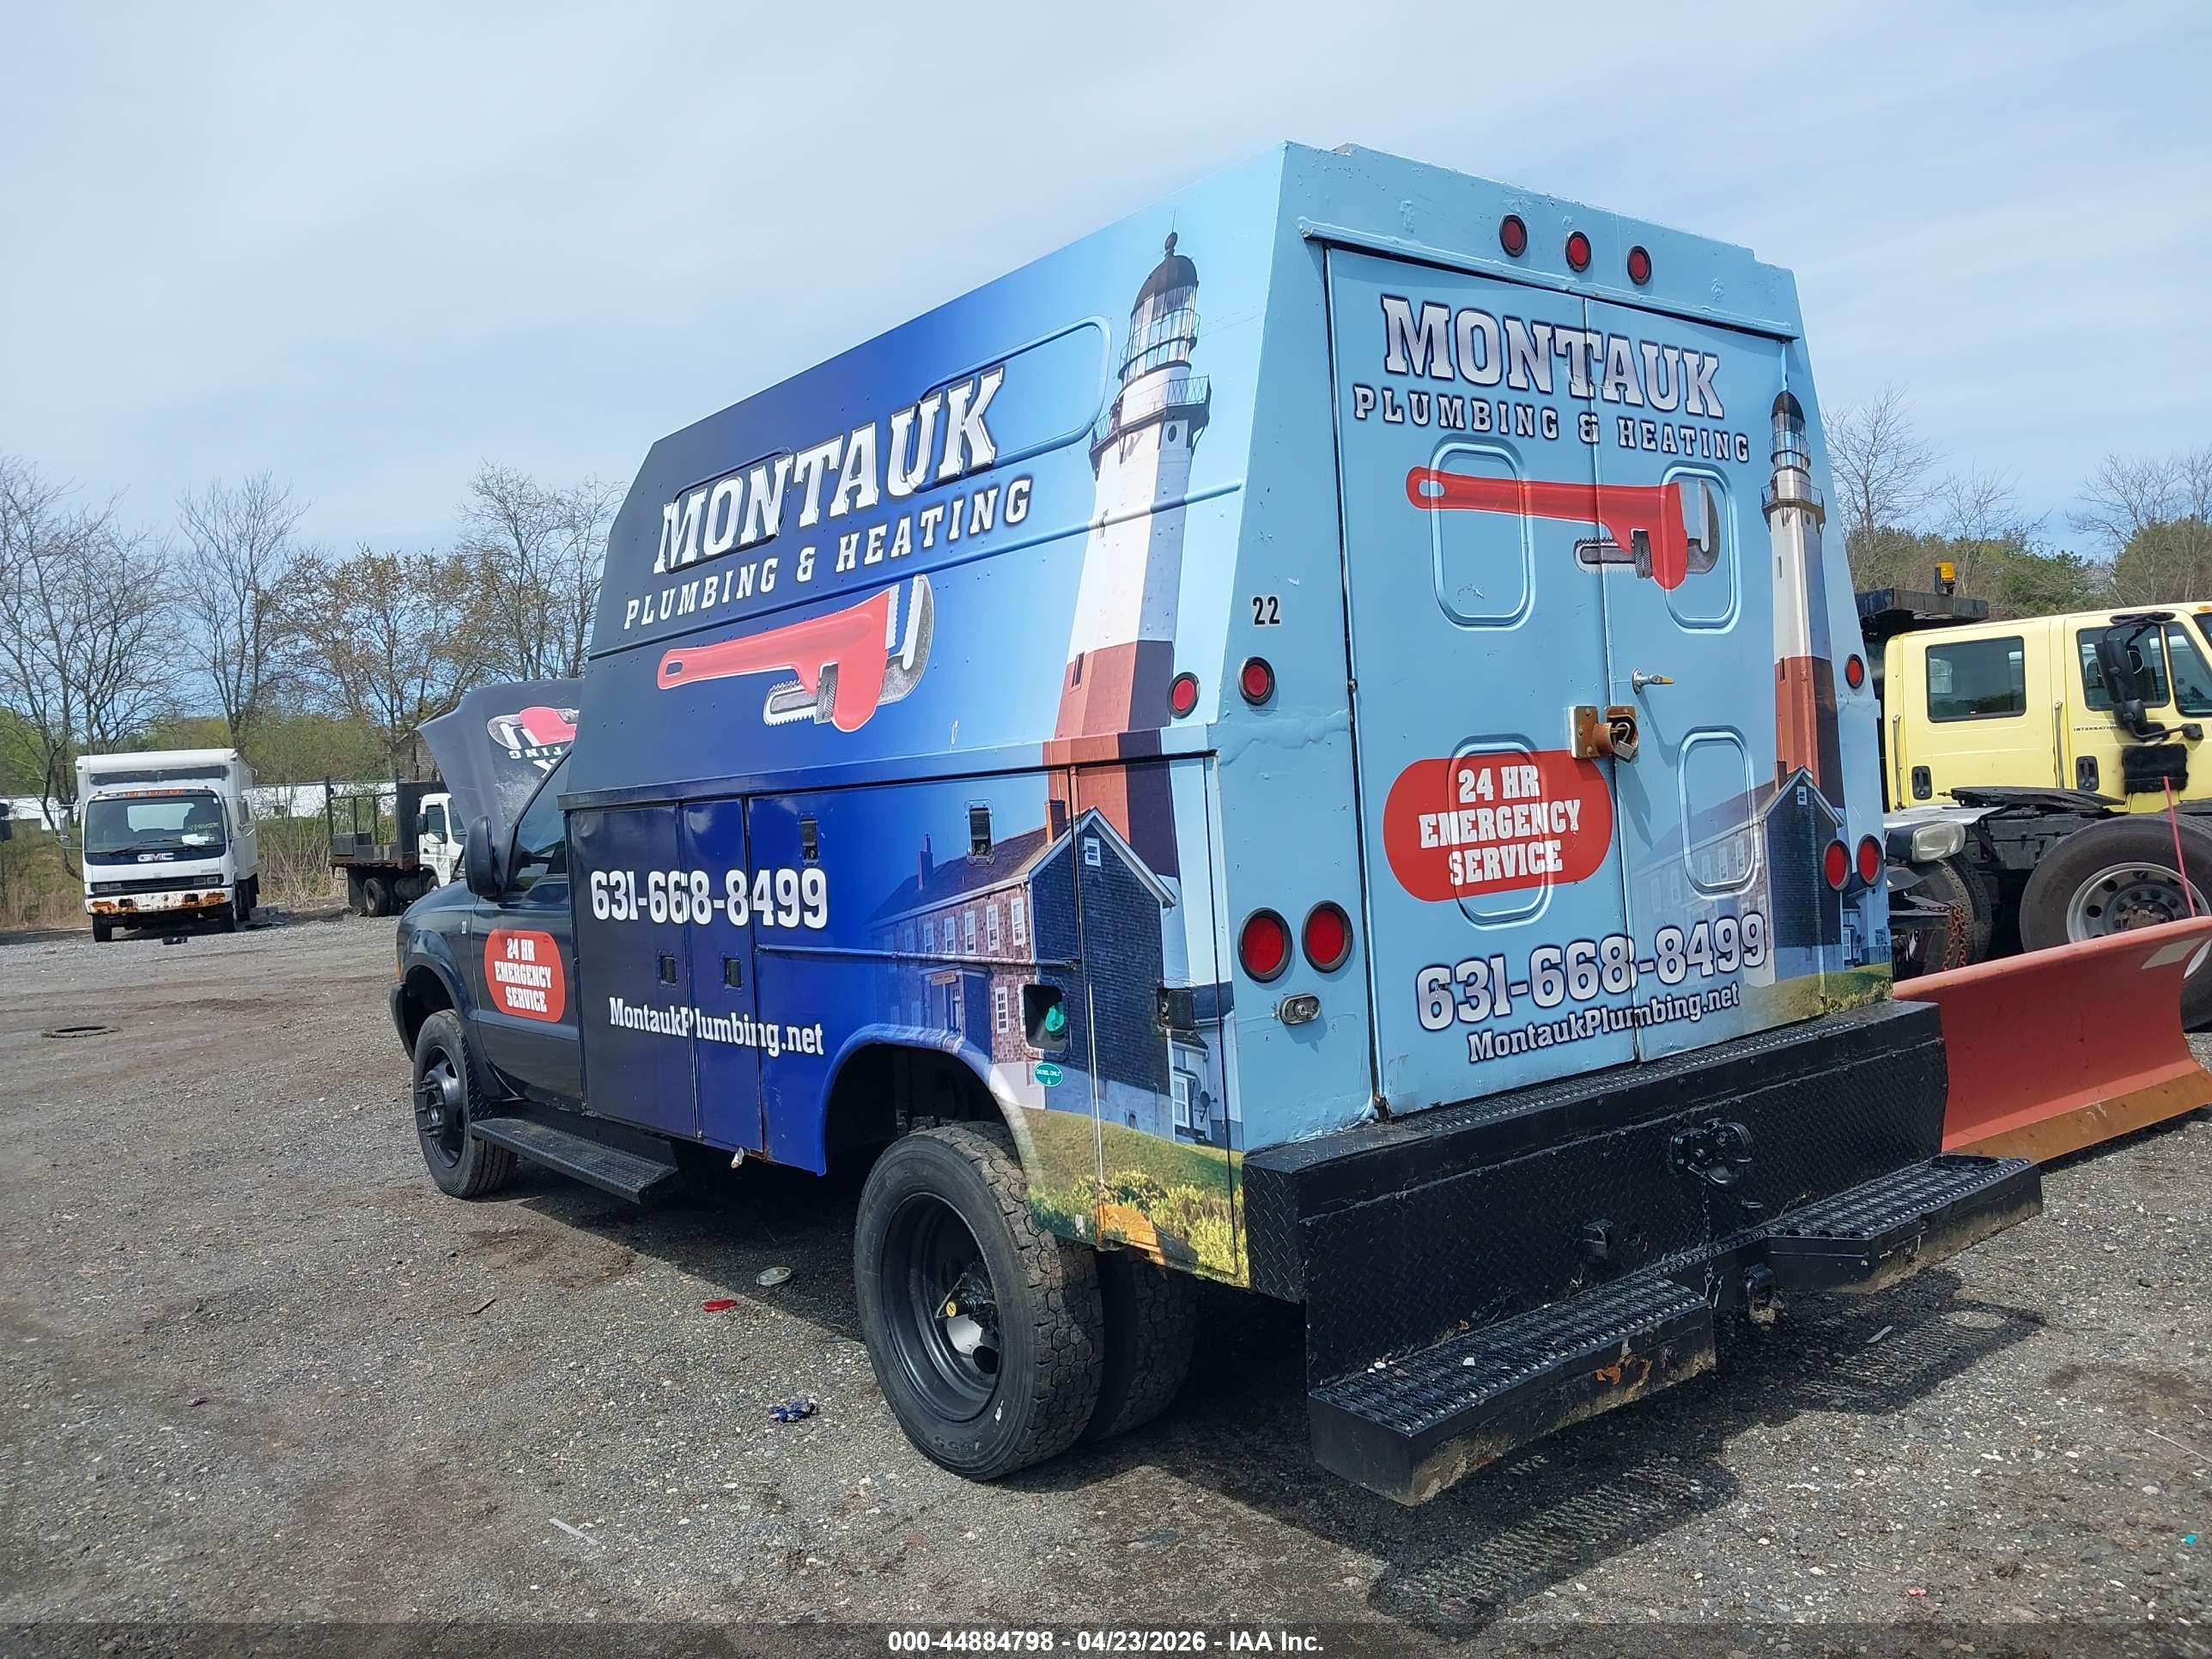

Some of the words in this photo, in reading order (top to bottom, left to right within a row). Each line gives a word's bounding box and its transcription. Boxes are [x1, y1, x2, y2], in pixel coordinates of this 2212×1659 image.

[1382, 295, 1724, 419] MONTAUK
[1354, 386, 1559, 439] PLUMBING
[1579, 414, 1600, 443] &
[1618, 418, 1749, 462] HEATING
[653, 367, 1003, 574] MONTAUK
[624, 558, 779, 629] PLUMBING
[797, 547, 817, 582] &
[836, 479, 1031, 573] HEATING
[1253, 596, 1280, 625] 22
[1458, 768, 1494, 803] 24
[1501, 765, 1540, 799] HR
[1419, 799, 1581, 848] EMERGENCY
[137, 852, 174, 862] GMC
[1449, 840, 1564, 885] SERVICE
[590, 868, 828, 928] 631-668-8499
[495, 961, 552, 988] EMERGENCY
[507, 938, 520, 959] 24
[520, 939, 535, 961] HR
[1417, 912, 1766, 1030] 631-668-8499
[505, 986, 548, 1012] SERVICE
[1468, 982, 1740, 1063] MontaukPlumbing.net
[609, 997, 824, 1057] MontaukPlumbing.net
